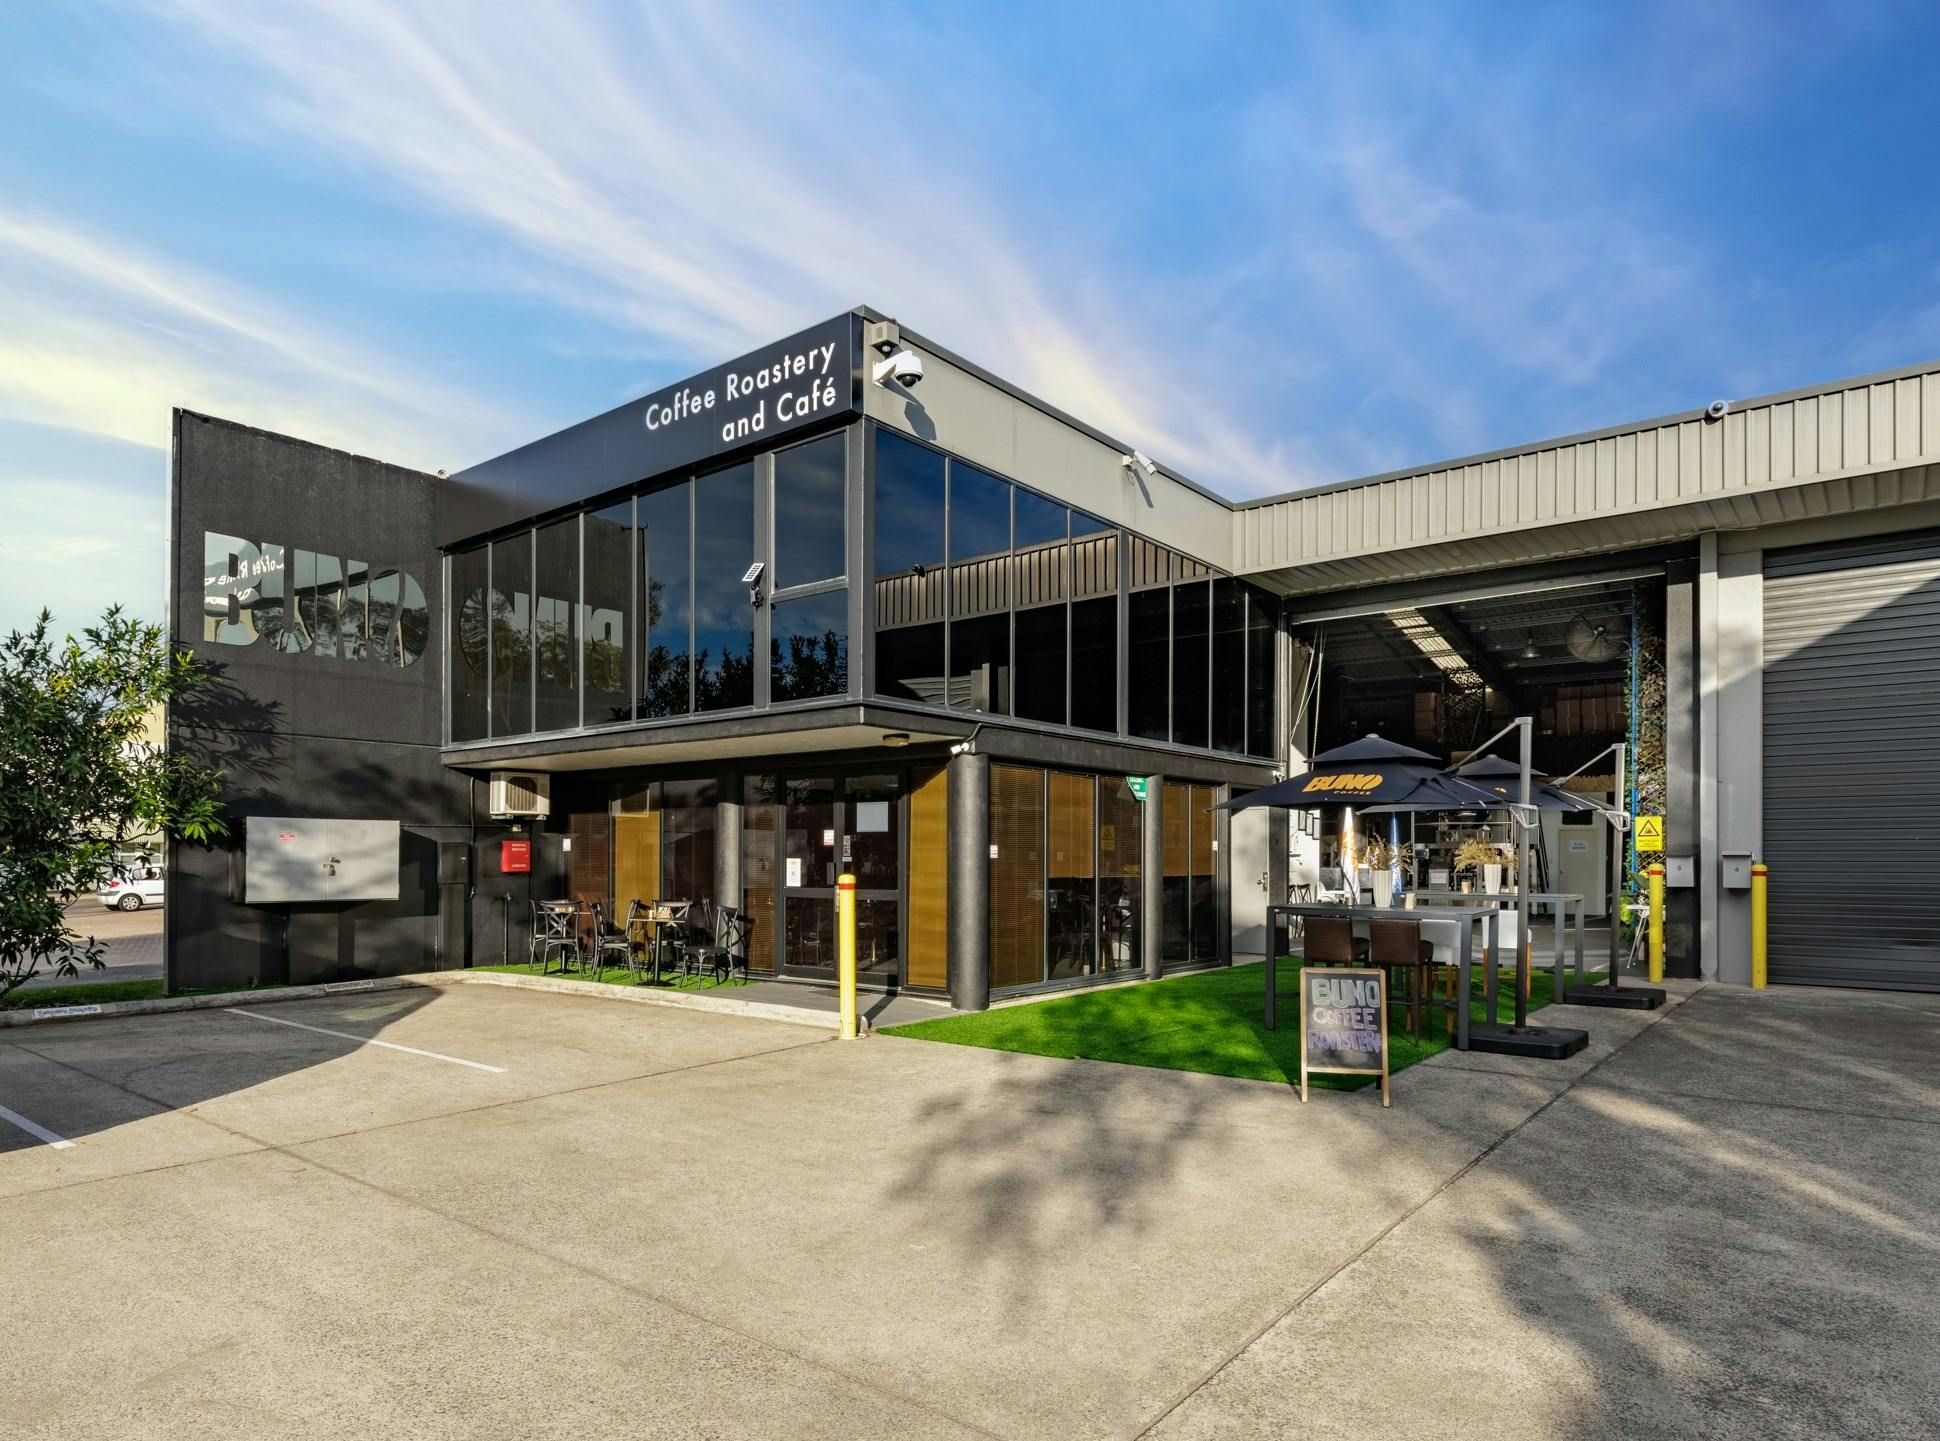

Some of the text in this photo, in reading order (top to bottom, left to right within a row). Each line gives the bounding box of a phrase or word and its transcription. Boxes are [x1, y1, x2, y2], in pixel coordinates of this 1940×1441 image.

[645, 342, 836, 430] Coffee Roastery
[722, 377, 836, 442] and Café
[203, 531, 431, 668] BUNO
[1302, 774, 1383, 792] BUNO
[1311, 978, 1381, 1008] BUNO
